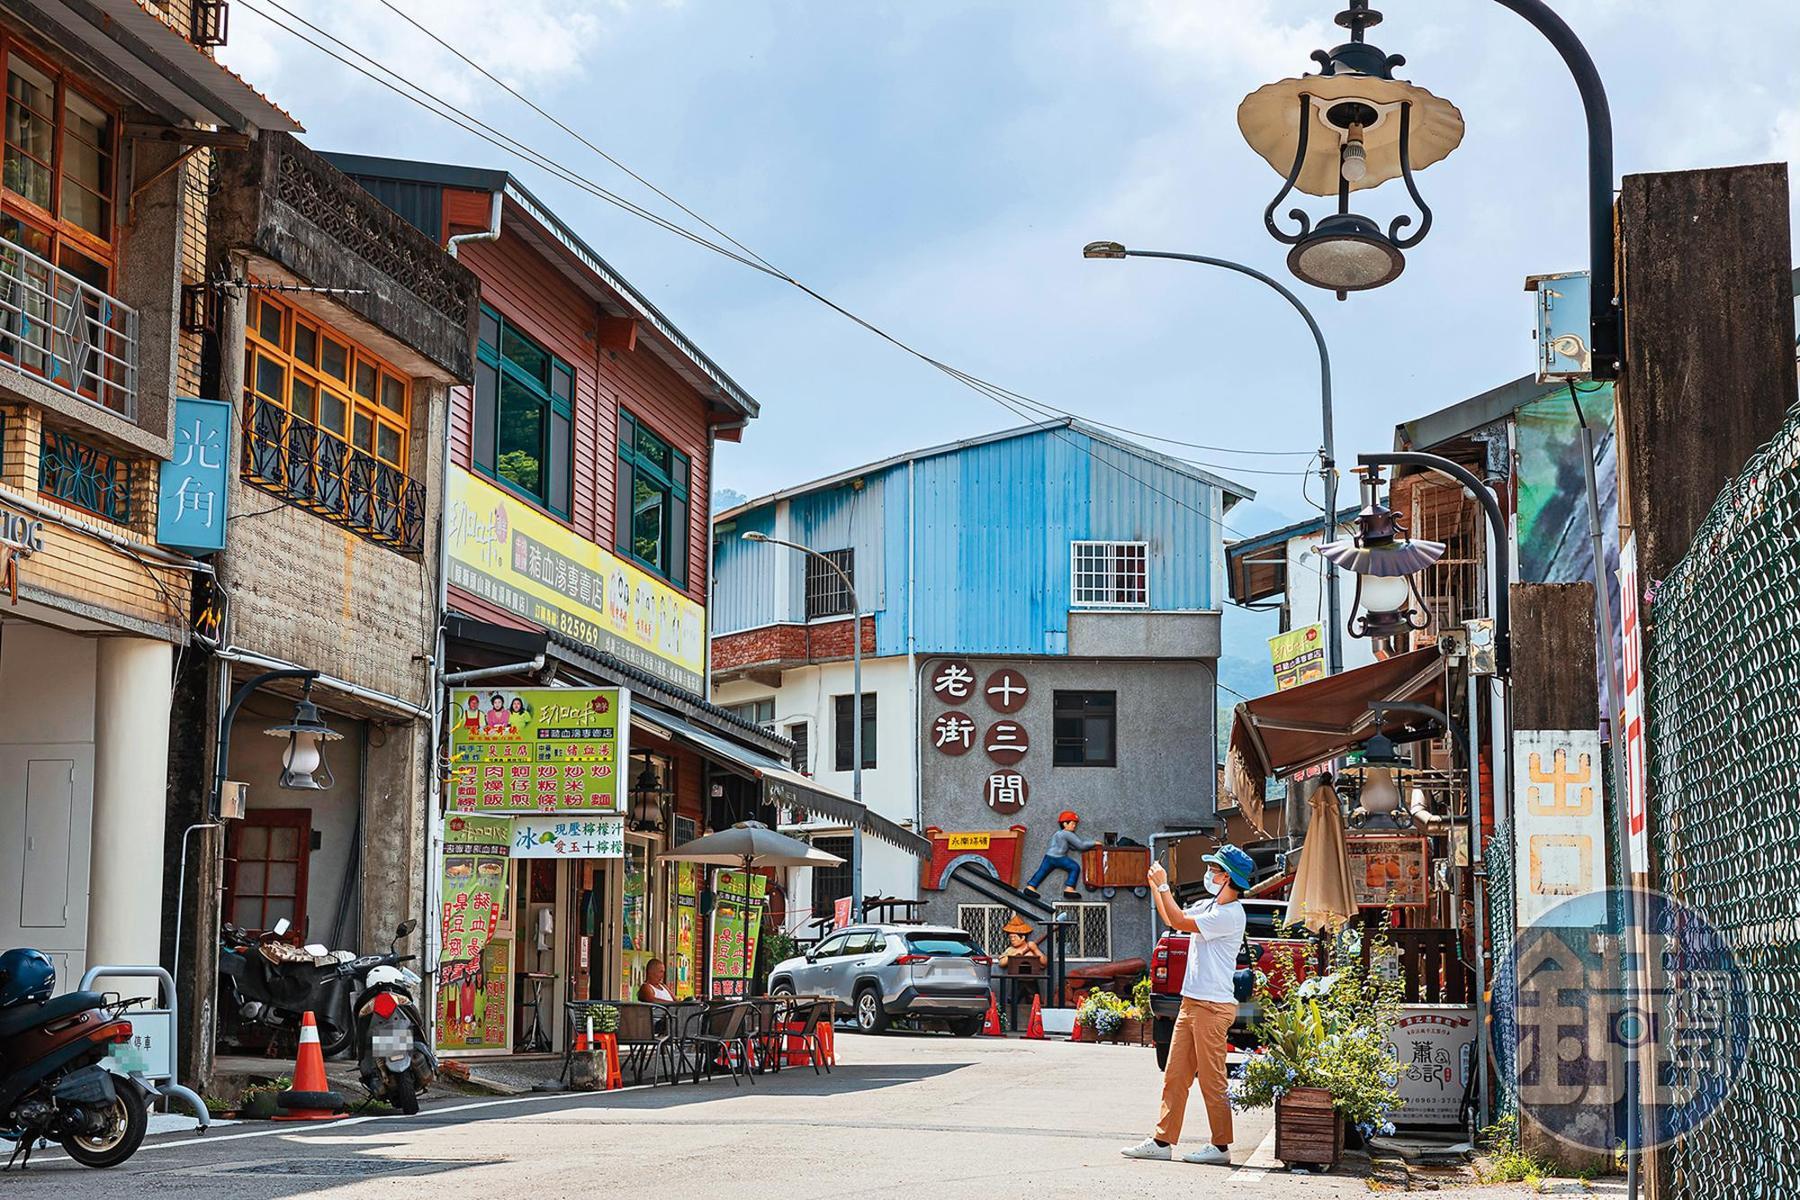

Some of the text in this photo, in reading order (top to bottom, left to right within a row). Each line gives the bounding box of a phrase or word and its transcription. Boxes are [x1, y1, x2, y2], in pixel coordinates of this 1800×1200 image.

[172, 418, 221, 529] 光角
[560, 613, 599, 645] 825969
[934, 664, 975, 748] 老街
[987, 675, 1028, 807] 十三間
[483, 766, 504, 806] 肉燥飯
[510, 766, 530, 806] 蚵仔煎
[564, 766, 584, 806] 炒米粉
[516, 826, 538, 850] 冰
[554, 821, 624, 837] 現壓檸檬汁
[1527, 748, 1593, 896] 出口
[131, 1034, 151, 1051] 停車
